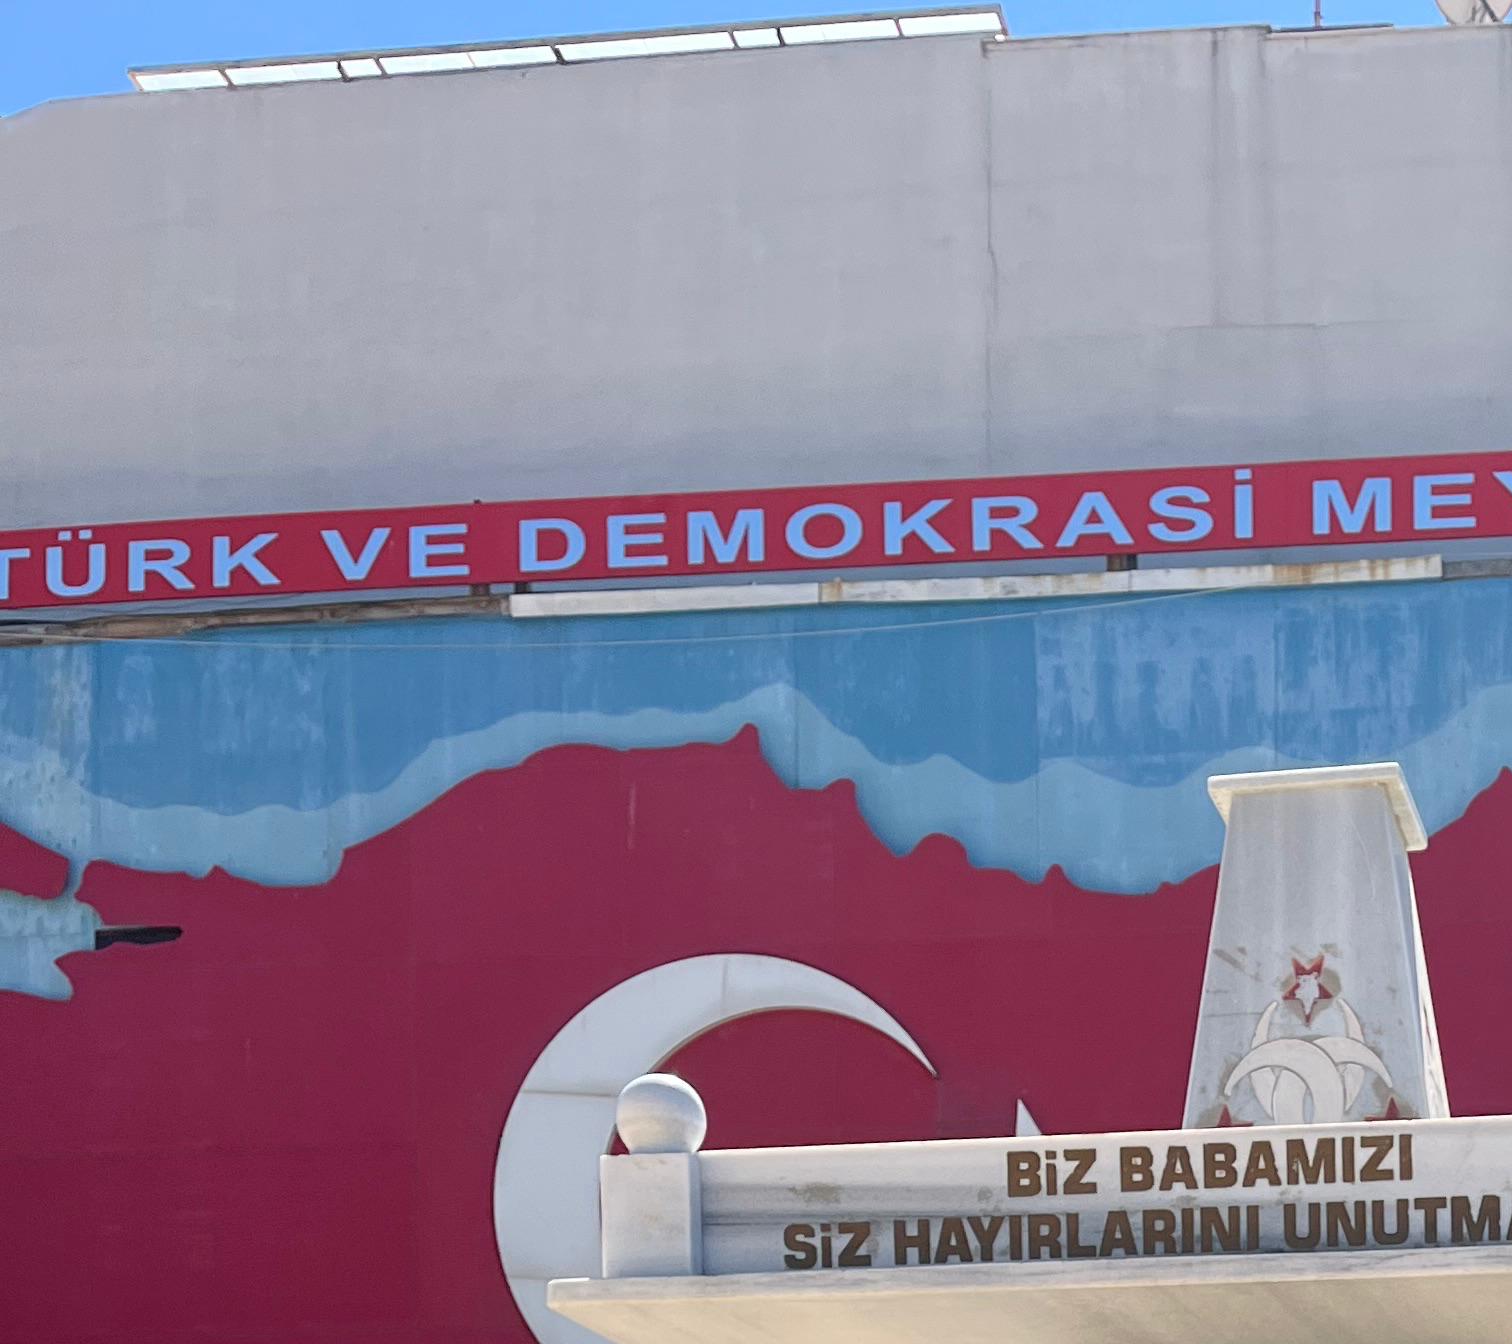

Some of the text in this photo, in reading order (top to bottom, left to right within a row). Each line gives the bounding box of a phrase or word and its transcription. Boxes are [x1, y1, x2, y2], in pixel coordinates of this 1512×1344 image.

[320, 523, 471, 582] VE
[517, 468, 1255, 574] DEMOKRASİ
[1118, 1133, 1413, 1193] BABAMIZI
[893, 1203, 1261, 1266] HAYIRLARINI
